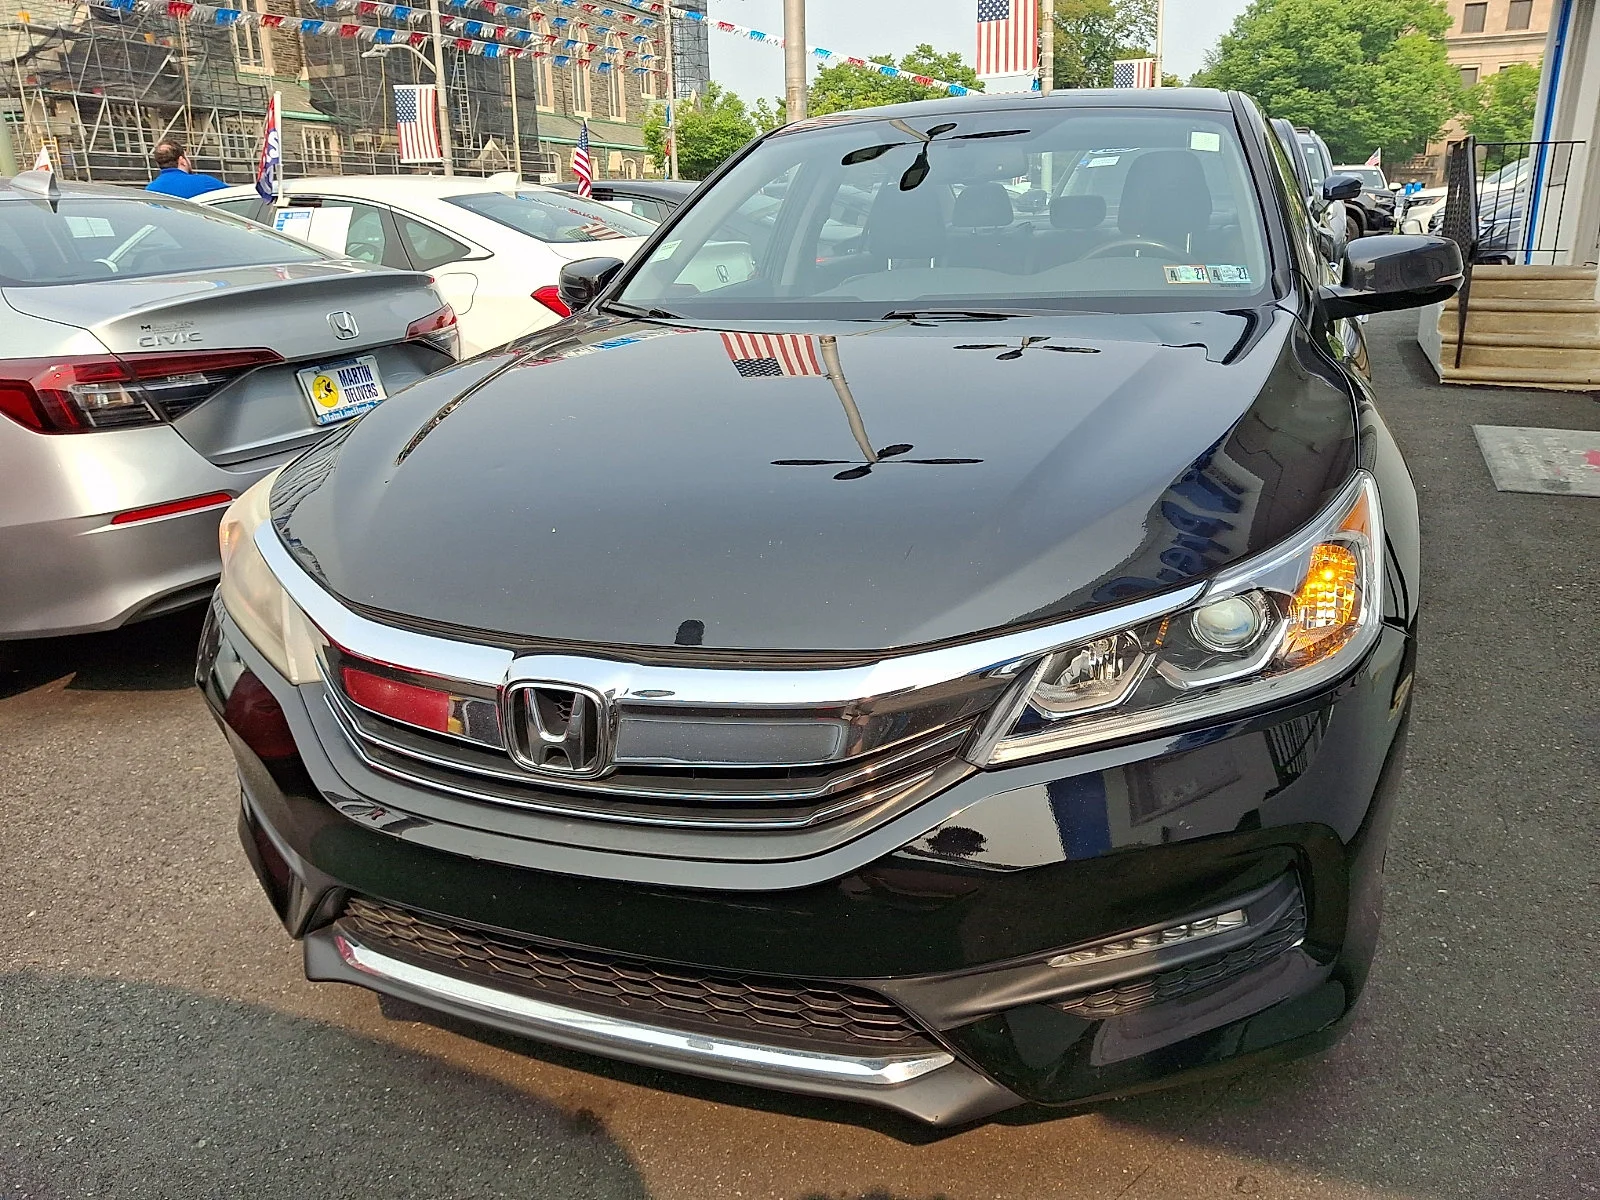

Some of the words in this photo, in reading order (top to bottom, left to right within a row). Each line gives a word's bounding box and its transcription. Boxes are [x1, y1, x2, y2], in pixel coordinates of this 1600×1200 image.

[138, 331, 203, 347] CIVIC
[337, 364, 374, 388] MARTIN
[344, 382, 379, 403] DELIVERS
